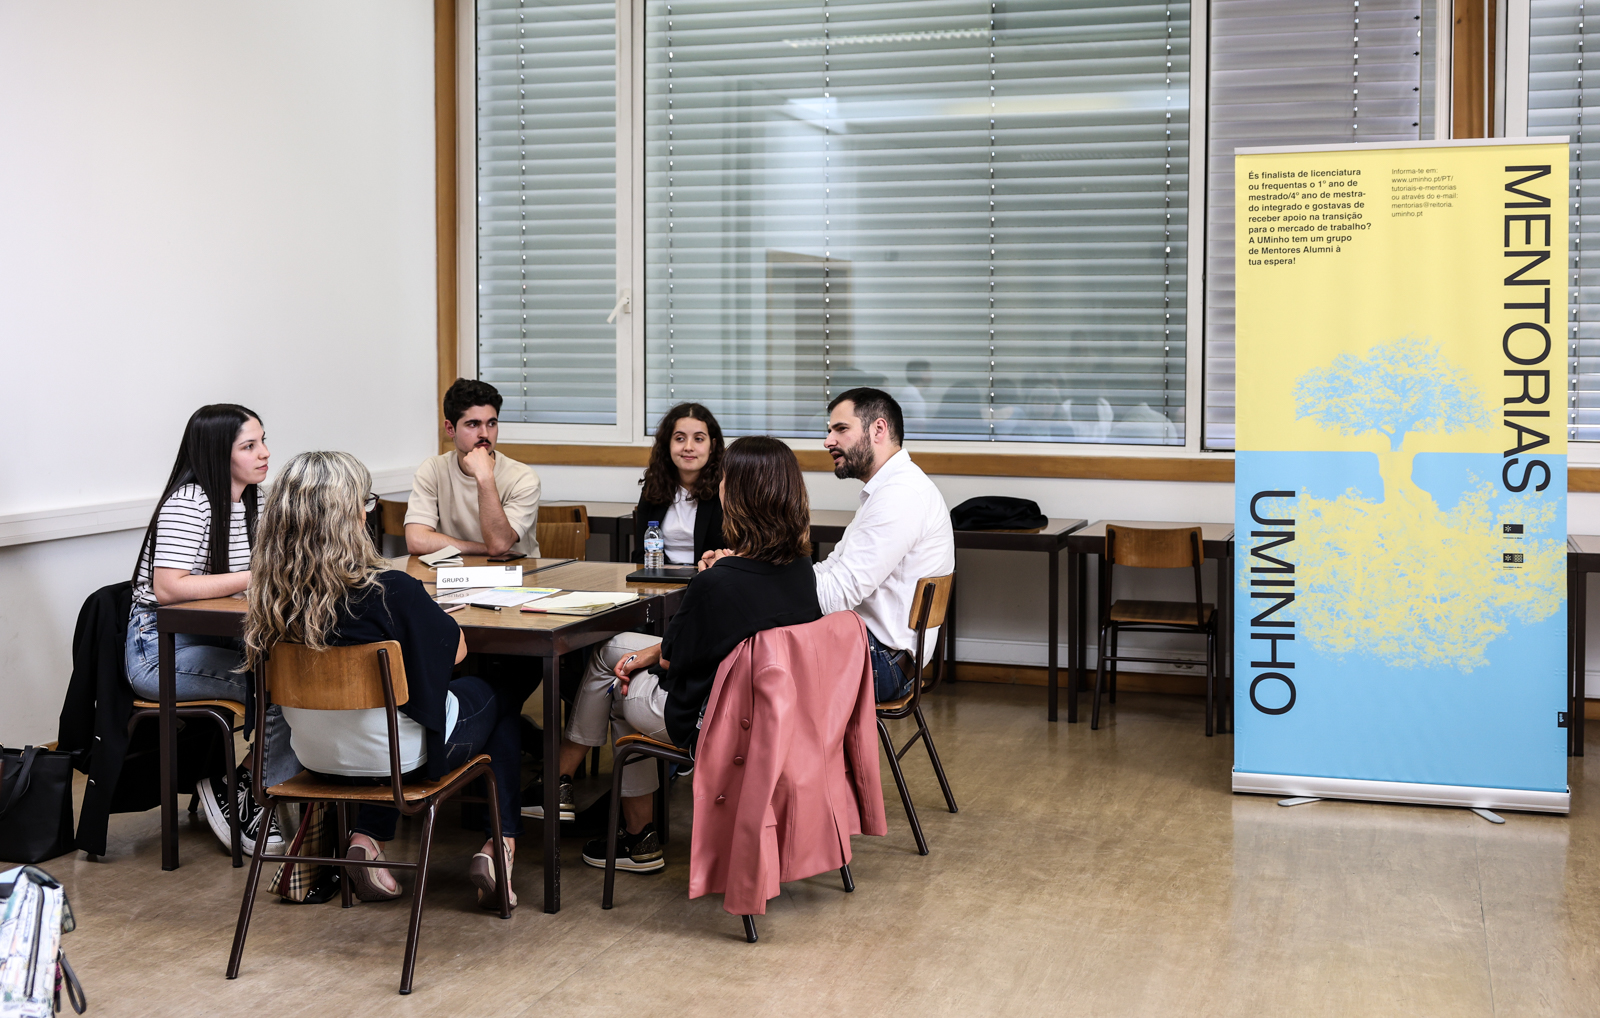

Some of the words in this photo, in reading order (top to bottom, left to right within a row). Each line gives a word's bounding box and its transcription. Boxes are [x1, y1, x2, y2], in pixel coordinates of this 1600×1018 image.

[1248, 170, 1260, 181] És
[1261, 170, 1296, 179] finalista
[1297, 170, 1309, 178] de
[1310, 168, 1362, 178] licenciatura
[1391, 175, 1454, 183] www.uminho.pt/PT/
[1248, 183, 1260, 191] ou
[1261, 181, 1308, 192] frequentas
[1328, 180, 1345, 188] ano
[1346, 178, 1358, 187] de
[1391, 184, 1457, 192] tutoriais-e-mentorias
[1301, 192, 1318, 200] ano
[1319, 190, 1331, 199] de
[1332, 190, 1366, 199] mestra-
[1248, 204, 1260, 213] do
[1261, 202, 1303, 213] integrado
[1311, 202, 1352, 212] gostavas
[1353, 200, 1365, 209] de
[1248, 214, 1281, 223] receber
[1282, 213, 1307, 224] apoio
[1321, 211, 1363, 222] transição
[1391, 210, 1423, 218] uminho.pt
[1248, 226, 1268, 235] para
[1277, 224, 1315, 233] mercado
[1316, 223, 1328, 232] de
[1329, 222, 1372, 231] trabalho?
[1256, 235, 1290, 245] UMinho
[1291, 235, 1308, 243] tem
[1310, 235, 1324, 243] um
[1326, 235, 1353, 244] grupo
[1248, 247, 1260, 255] de
[1261, 246, 1301, 255] Mentores
[1302, 245, 1334, 254] Alumni
[1248, 258, 1262, 267] tua
[1263, 256, 1296, 267] espera!
[1502, 165, 1551, 492] MENTORIAS
[1249, 490, 1297, 715] UMINHO
